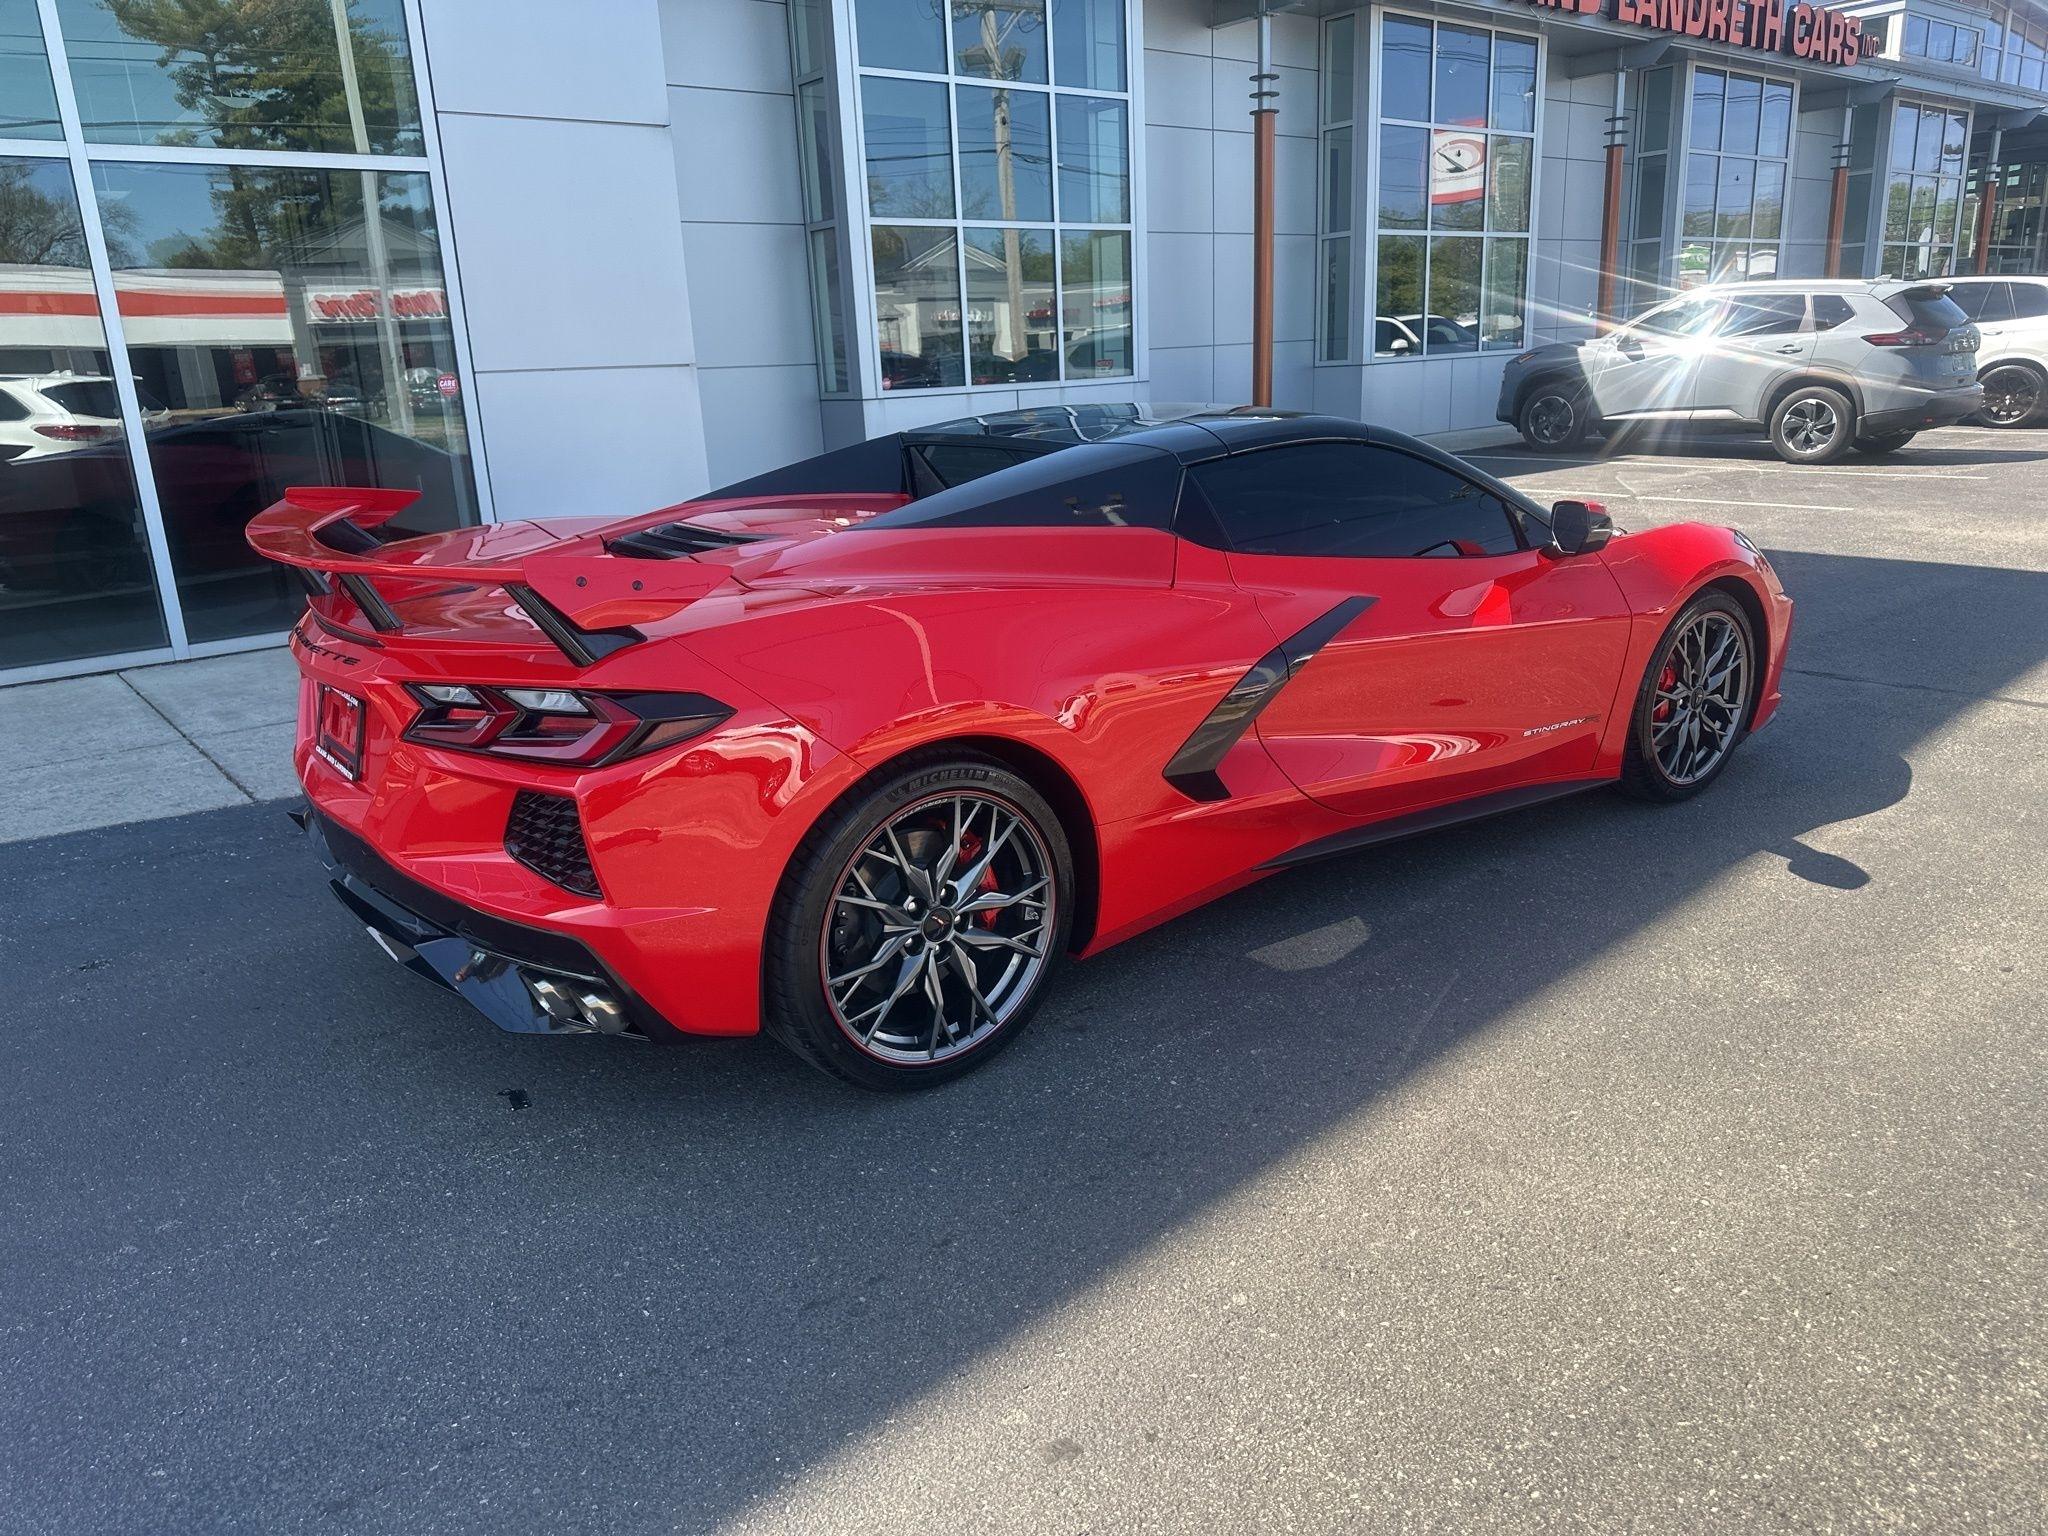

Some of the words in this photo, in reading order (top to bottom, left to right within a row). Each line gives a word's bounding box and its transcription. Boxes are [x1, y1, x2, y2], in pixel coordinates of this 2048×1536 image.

[1792, 3, 1860, 67] CARS
[1861, 33, 1880, 57] INC
[294, 625, 361, 667] VETTE
[1522, 717, 1586, 737] STINGRAY
[908, 768, 986, 792] MICHELIN
